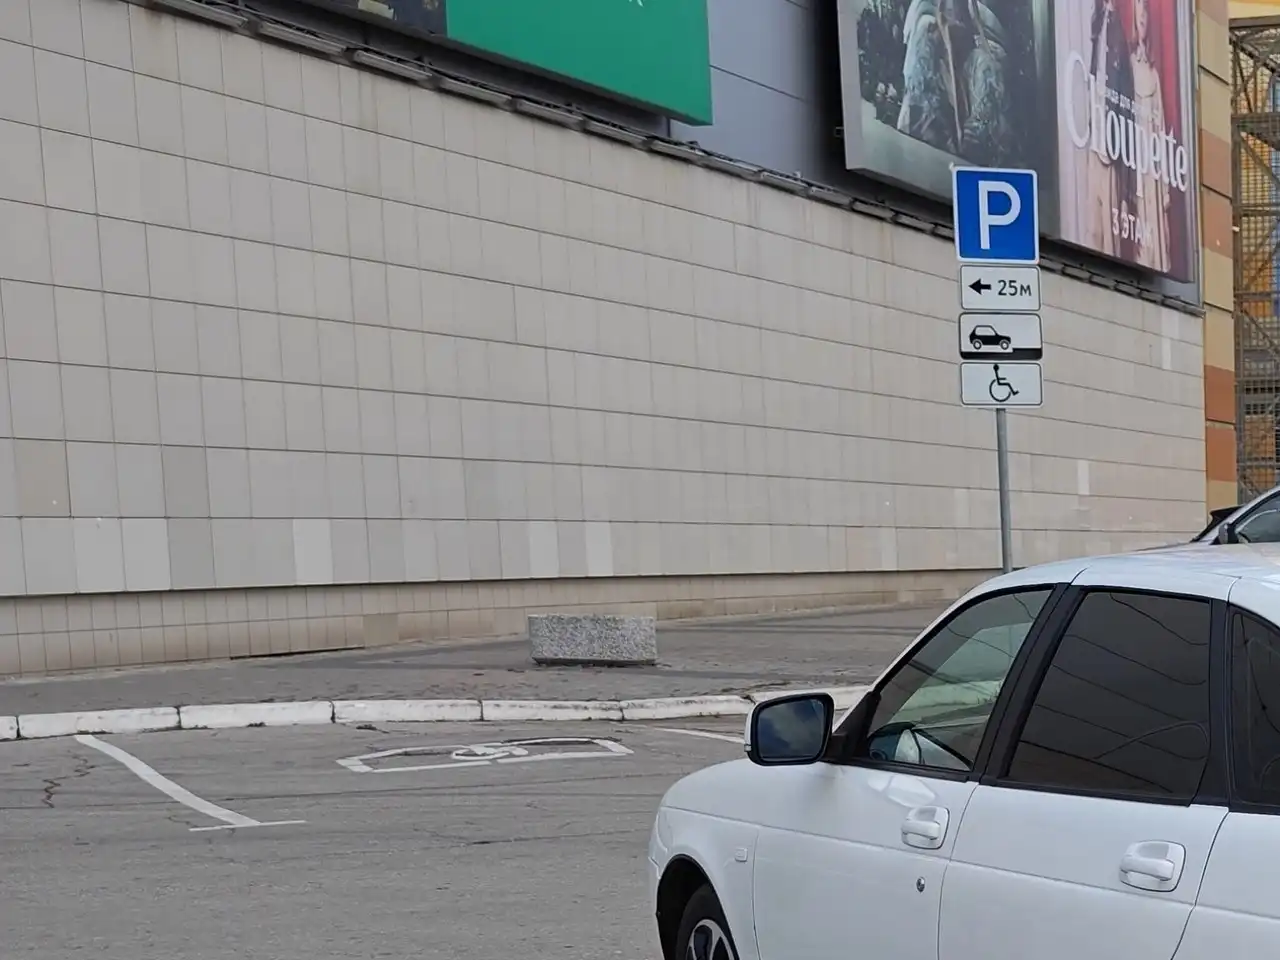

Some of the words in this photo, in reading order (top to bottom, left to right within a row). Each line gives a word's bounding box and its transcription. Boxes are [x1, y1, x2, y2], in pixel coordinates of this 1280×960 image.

[1065, 52, 1188, 198] Choupette
[977, 179, 1022, 251] P
[1111, 206, 1120, 236] 3
